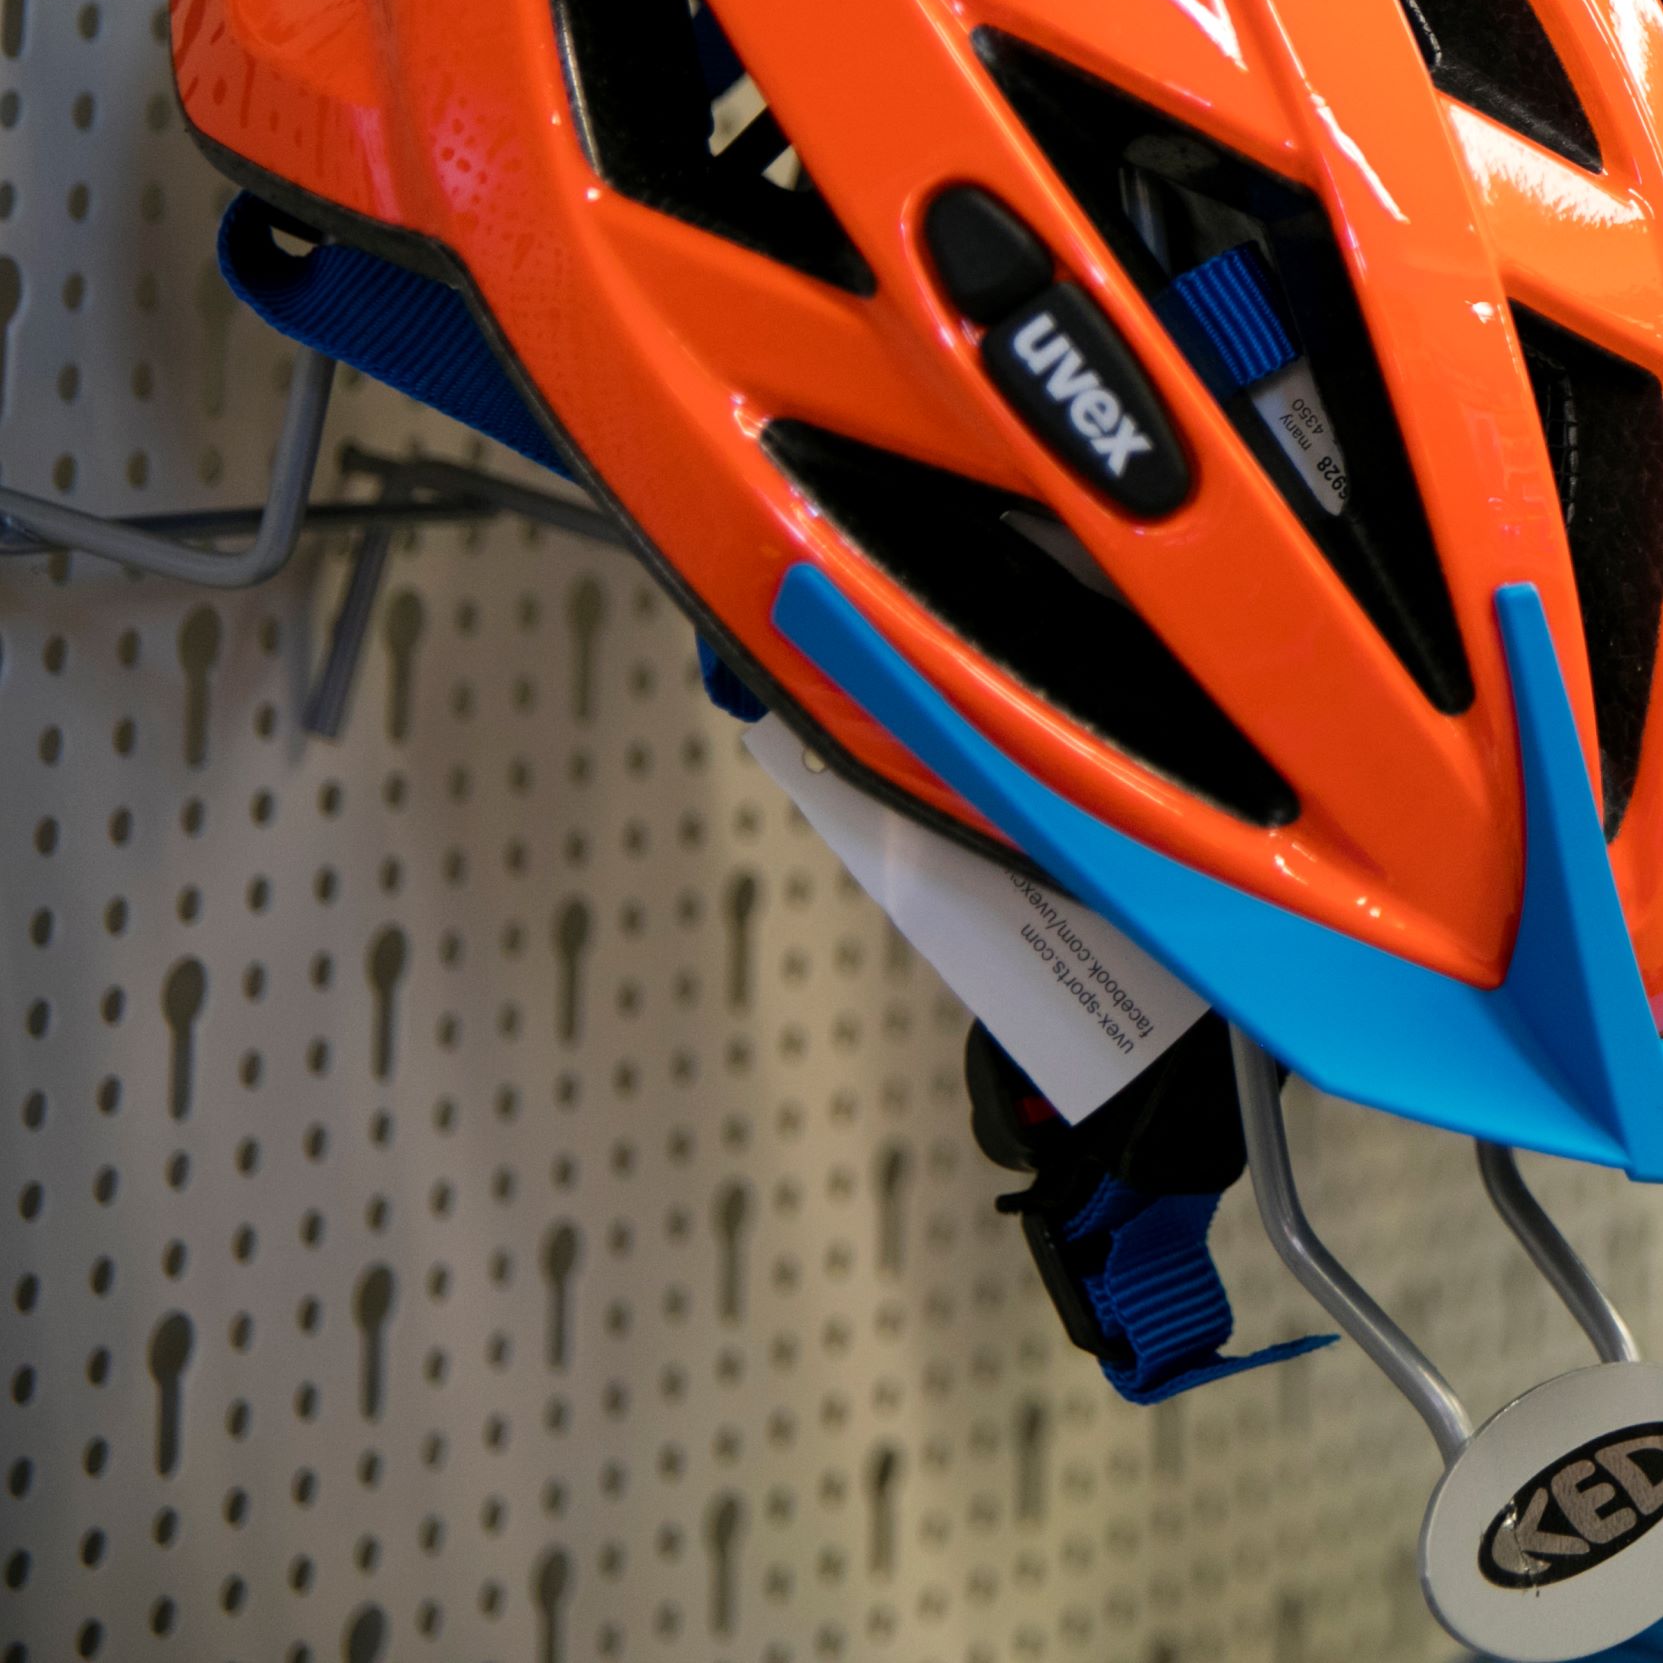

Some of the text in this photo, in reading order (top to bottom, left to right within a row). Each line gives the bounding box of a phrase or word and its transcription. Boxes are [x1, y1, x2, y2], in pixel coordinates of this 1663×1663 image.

[1012, 313, 1153, 478] uvex
[1279, 413, 1312, 452] many
[1291, 398, 1324, 435] 4350
[1020, 923, 1135, 1055] uvex-sports.com
